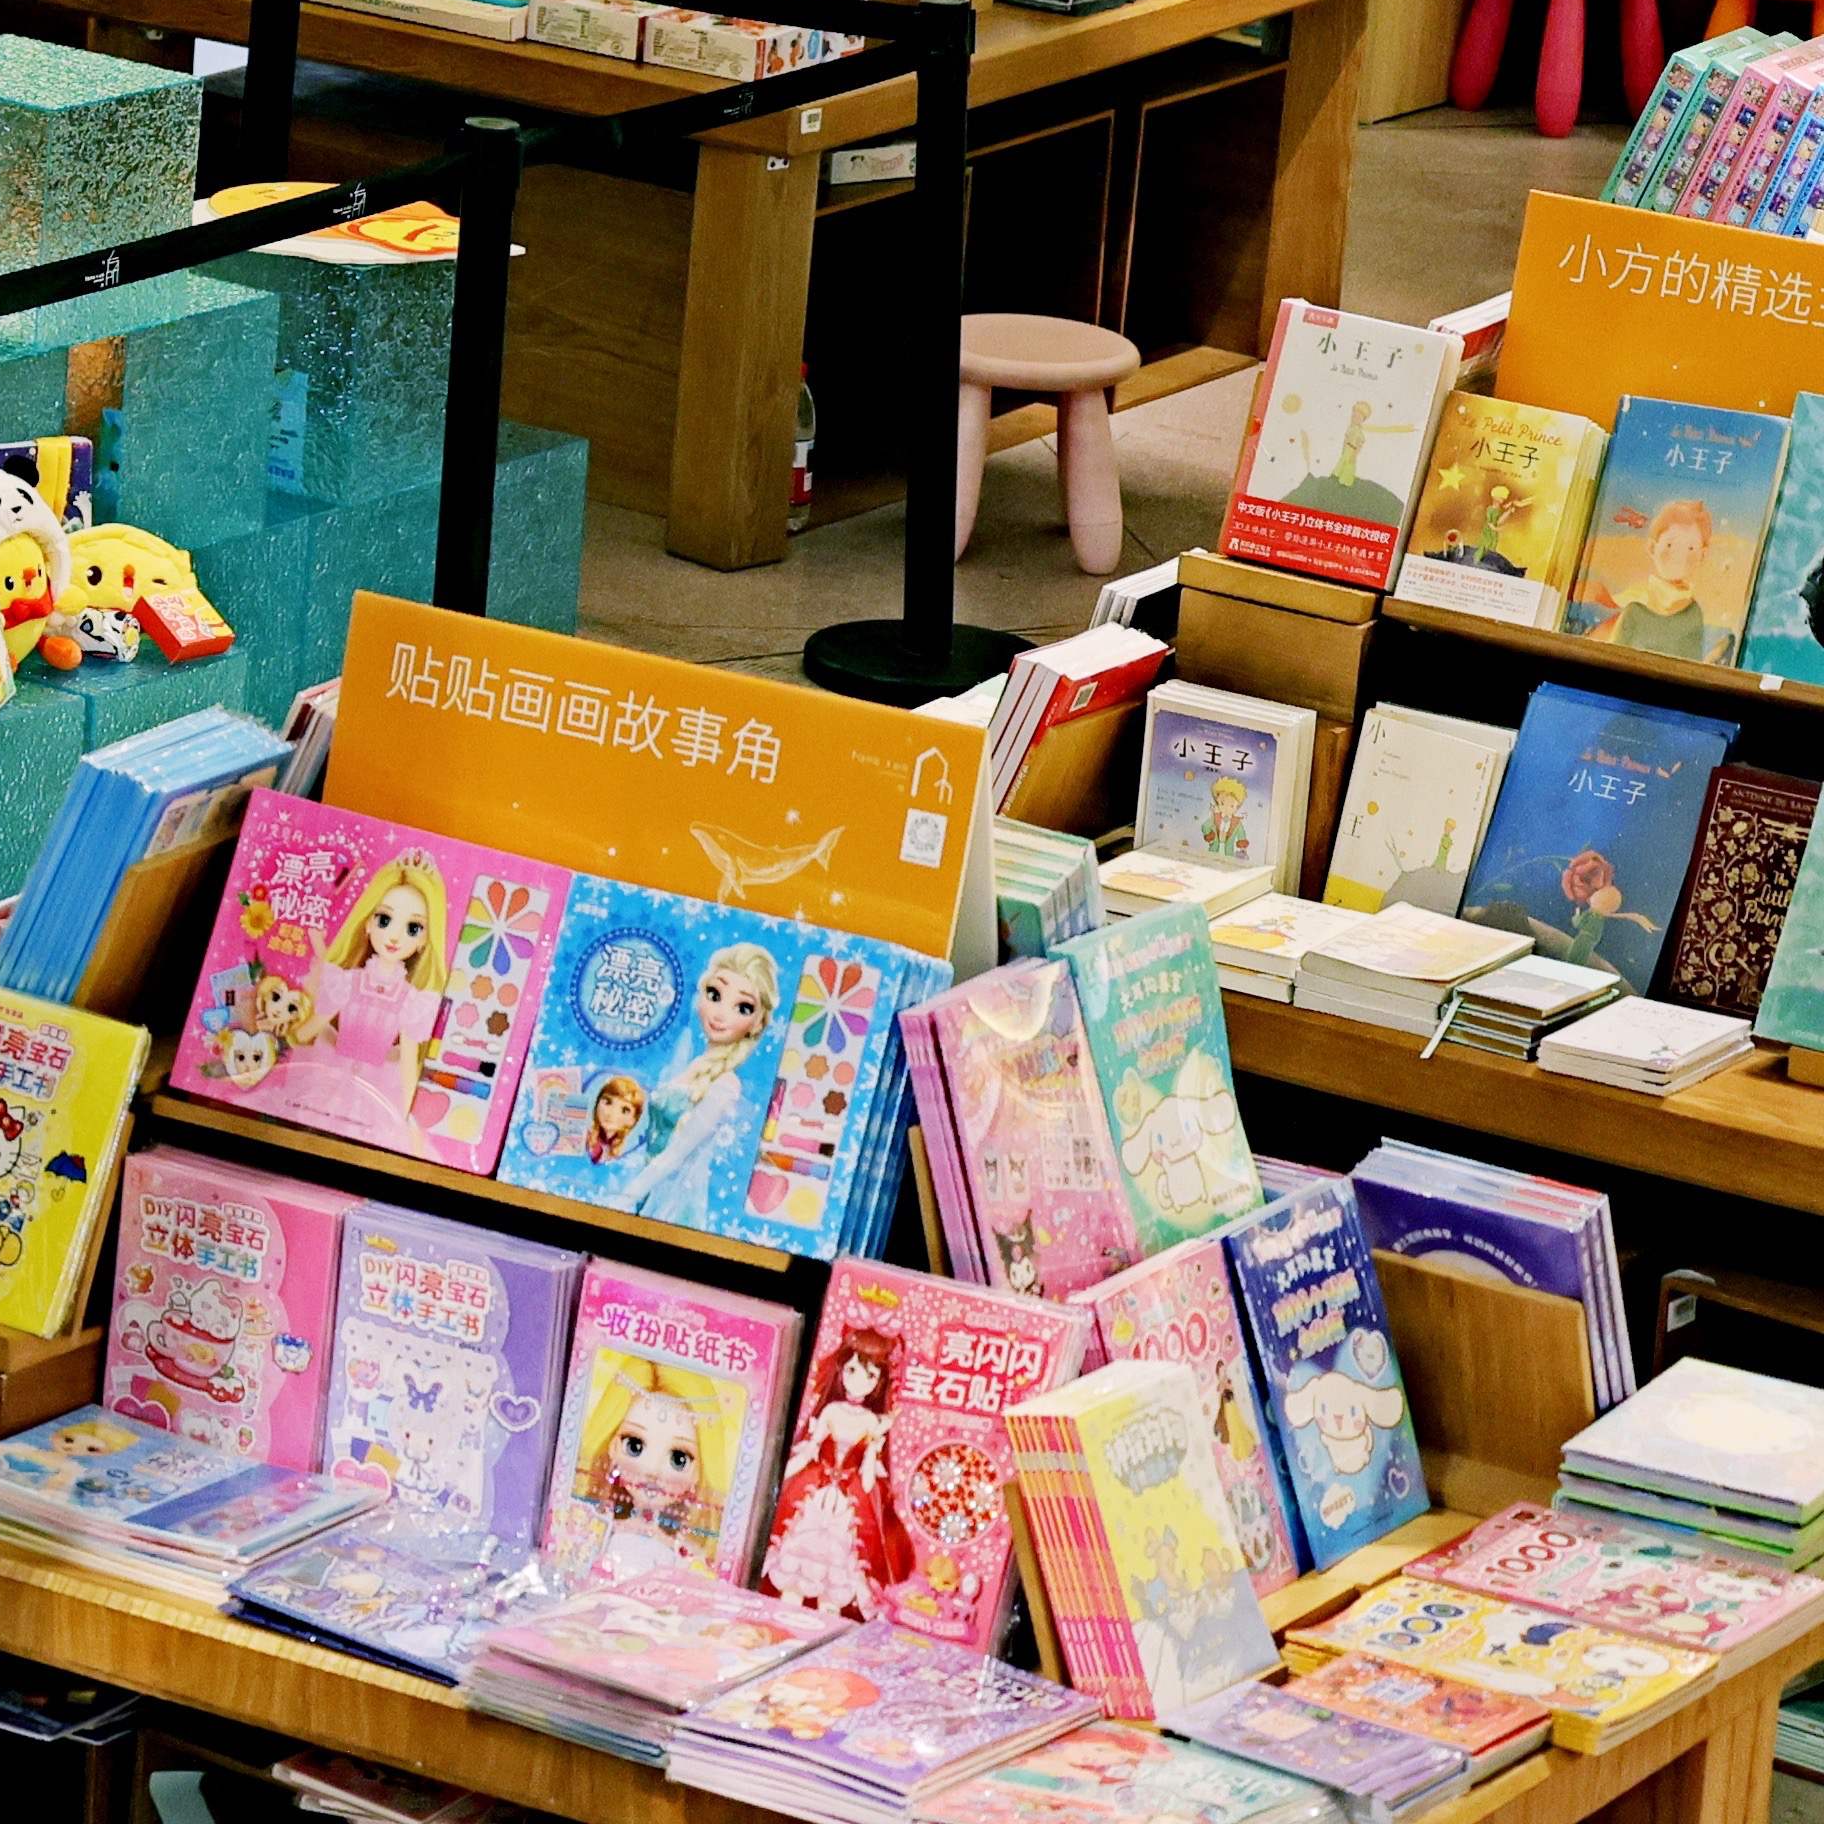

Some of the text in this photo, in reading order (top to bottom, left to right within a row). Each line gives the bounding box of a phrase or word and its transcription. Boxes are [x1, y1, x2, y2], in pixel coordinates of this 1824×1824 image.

[1558, 232, 1824, 330] 小方的精选
[1318, 331, 1405, 370] 小王子
[1469, 437, 1540, 470] 小王子
[1483, 416, 1515, 438] Petit
[1517, 423, 1563, 448] Prince
[1664, 442, 1734, 474] 小王子
[386, 641, 782, 785] 贴贴画画故事角
[1173, 737, 1254, 772] 小王子
[1568, 767, 1648, 805] 小王子
[275, 850, 336, 889] 漂亮
[271, 887, 331, 930] 秘密
[600, 943, 666, 989] 漂亮
[592, 983, 661, 1027] 秘密
[143, 1198, 265, 1252] DIY闪亮宝石
[147, 1222, 258, 1278] 立体手工书
[364, 1257, 488, 1310] DIY闪亮宝石
[366, 1280, 481, 1337] 立体手工书
[600, 1306, 753, 1374] 妆扮贴纸书
[939, 1328, 1043, 1379] 亮闪闪
[902, 1361, 1004, 1414] 宝石贴
